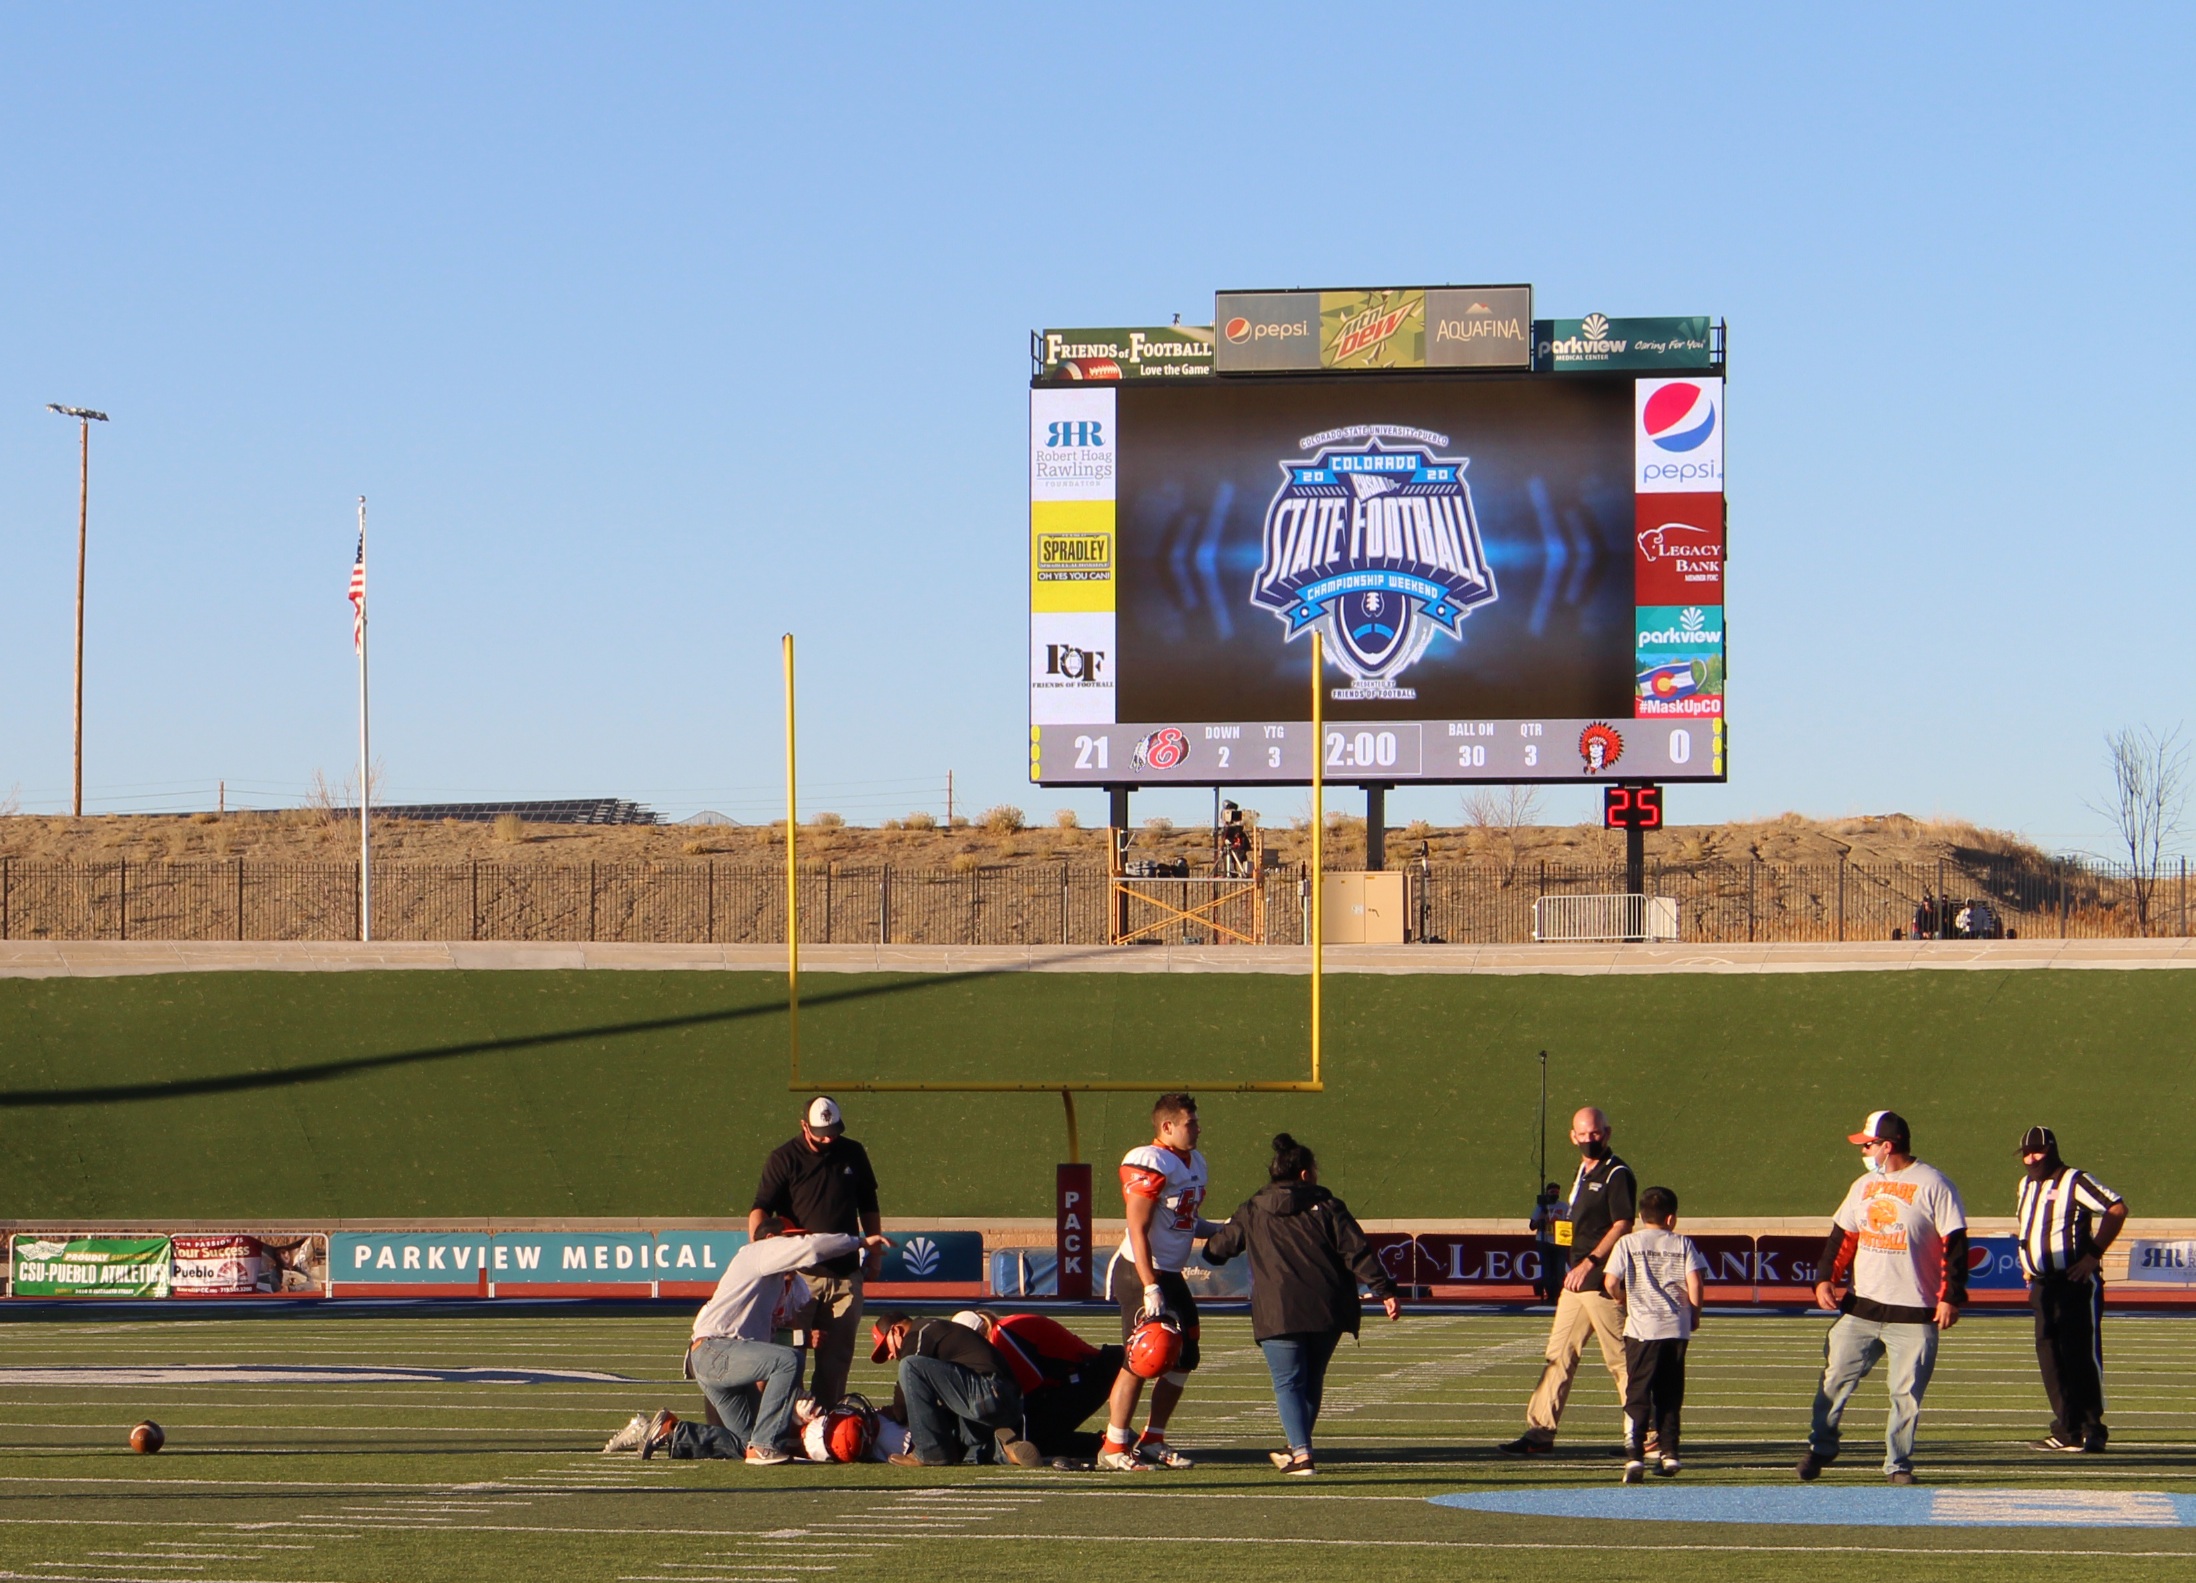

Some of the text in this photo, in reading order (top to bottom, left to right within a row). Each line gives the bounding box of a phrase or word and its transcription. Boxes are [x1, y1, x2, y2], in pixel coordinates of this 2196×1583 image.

[1254, 320, 1310, 342] pepsi
[1436, 318, 1522, 342] AQUAFINA
[1538, 336, 1628, 359] parkview
[1634, 339, 1704, 353] Caring For You
[1585, 353, 1609, 361] CENTER
[1140, 363, 1210, 376] Love the Game
[1300, 429, 1342, 449] COLORADO
[1342, 426, 1367, 437] STATE
[1036, 449, 1113, 463] Robert Hoag
[1331, 456, 1416, 471] COLORADO
[1036, 461, 1113, 480] Rawlings
[1302, 471, 1324, 482] 20
[1427, 469, 1448, 480] 20
[1643, 460, 1715, 483] pepsi
[1043, 540, 1105, 561] SPRADLEY
[1263, 496, 1486, 588] STATE FOOTBALL
[1038, 572, 1052, 580] OH
[1054, 572, 1068, 580] YES
[1069, 572, 1088, 580] YOU
[1307, 574, 1438, 600] CHAMPIONSHIP WEEKEND
[1638, 628, 1721, 648] parkview
[1332, 689, 1416, 698] FRIENDS OF FOOTBALL
[1639, 699, 1721, 715] #MaskUpCO
[1205, 726, 1240, 739] DOWN
[1263, 726, 1284, 739] YTG
[1448, 723, 1494, 736] BALL ON
[1520, 723, 1542, 737] QTR
[1074, 735, 1109, 769] 21
[1326, 732, 1397, 767] 2:00
[1458, 745, 1485, 767] 30
[1524, 745, 1538, 767] 3
[1669, 729, 1690, 763] 0
[1218, 746, 1229, 768] 2
[1268, 746, 1281, 768] 3
[1608, 790, 1658, 826] 25
[1064, 1191, 1082, 1274] PACK
[64, 1253, 109, 1262] PROUDLY
[202, 1246, 250, 1258] Success
[354, 1244, 717, 1270] PARKVIEW MEDICAL
[19, 1261, 97, 1284] CSU-PUEBLO
[173, 1265, 214, 1278] Pueblo
